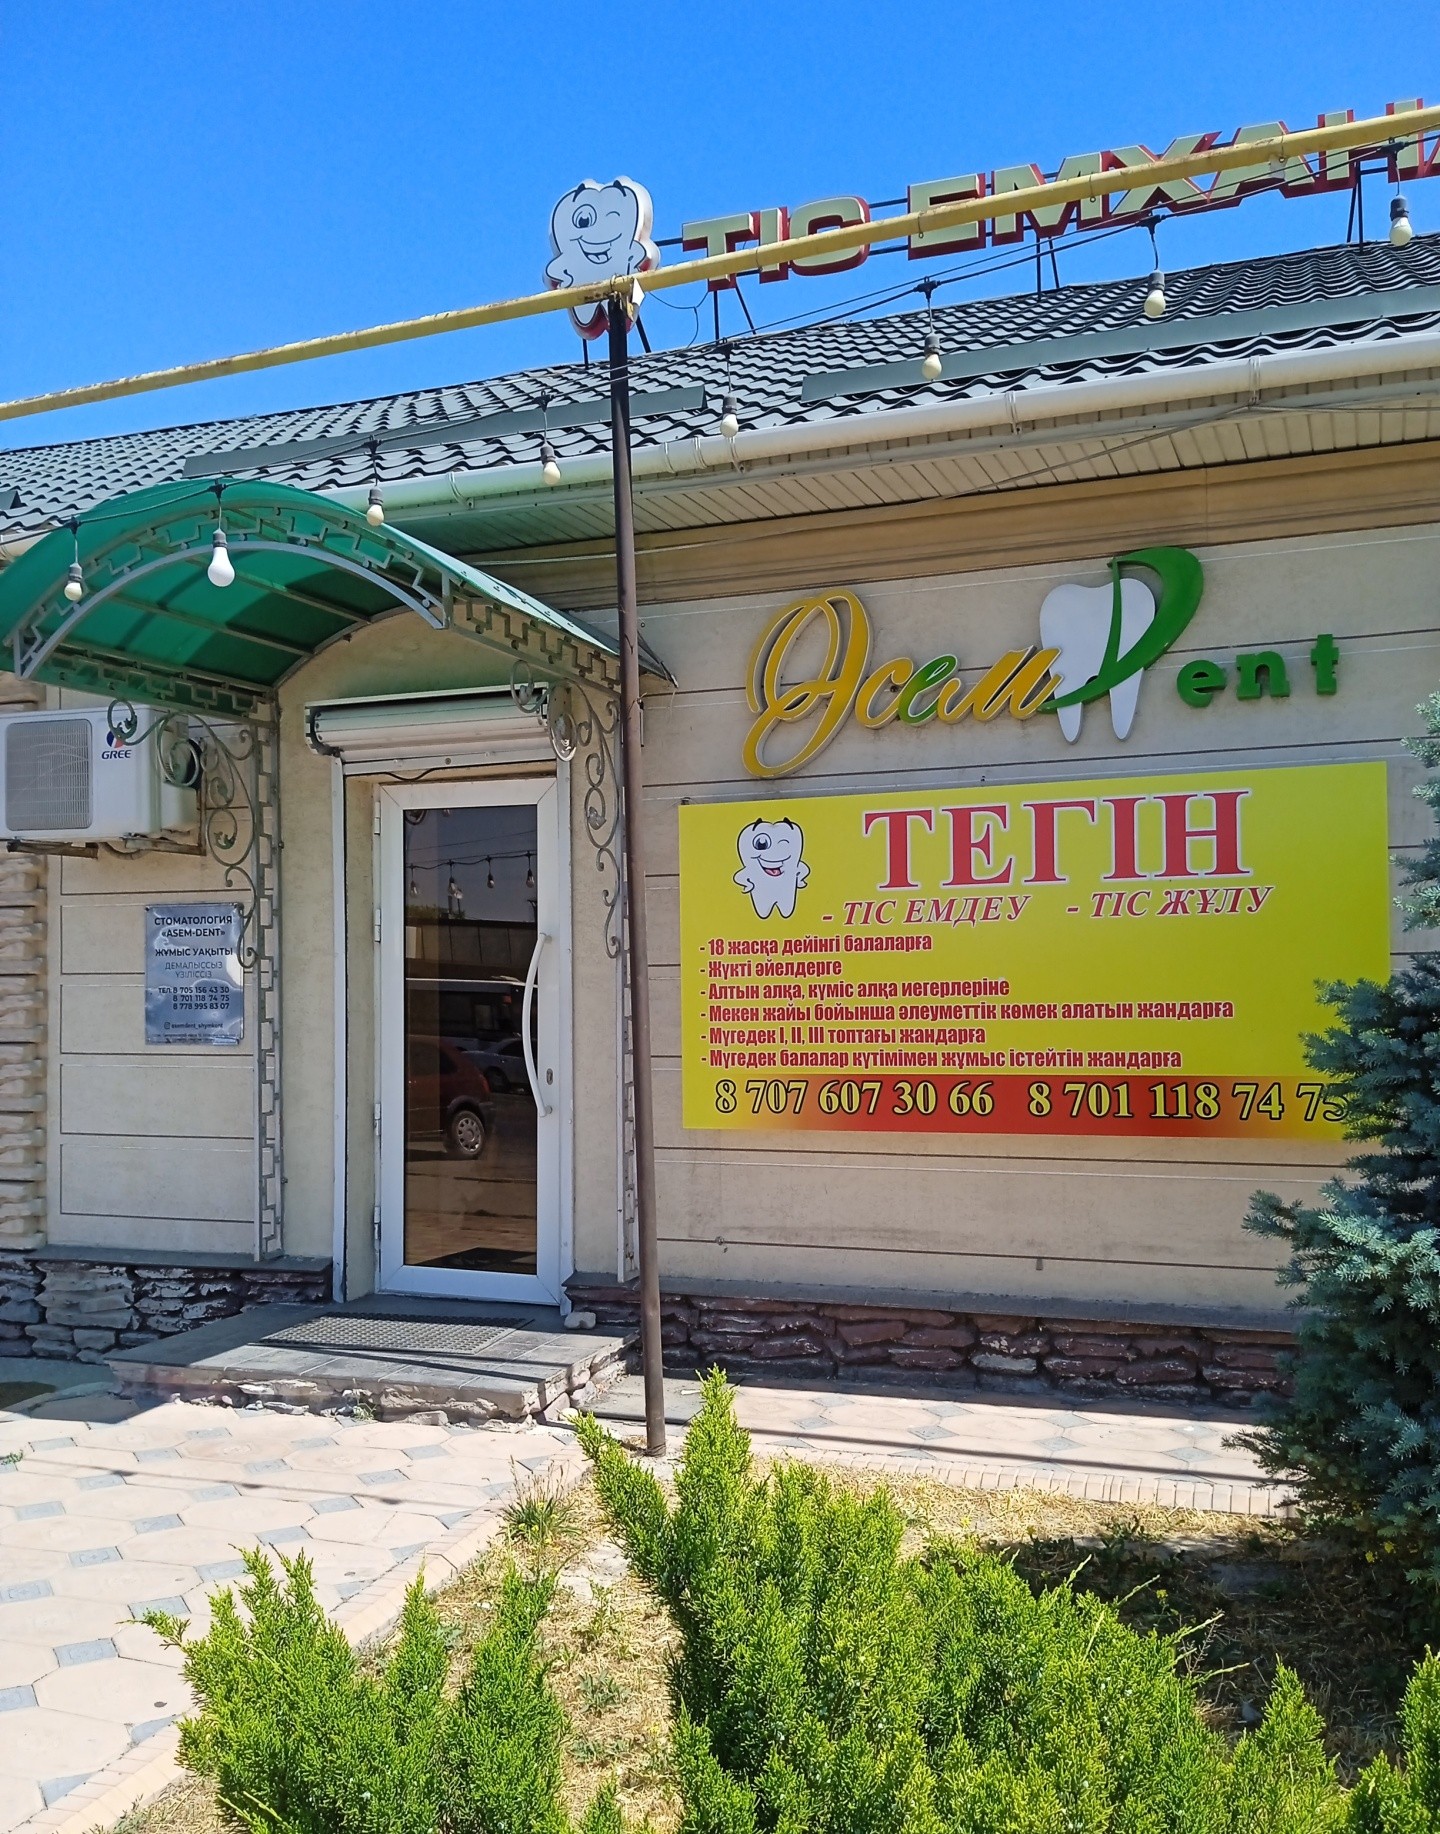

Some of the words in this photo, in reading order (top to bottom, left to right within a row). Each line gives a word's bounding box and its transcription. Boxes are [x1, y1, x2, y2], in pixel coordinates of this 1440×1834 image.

[907, 96, 1440, 261] ЕМХАН
[1037, 546, 1341, 714] Dent
[101, 749, 132, 760] GREE
[863, 789, 1251, 890] ТЕГІН
[843, 900, 896, 925] ТІС
[903, 895, 1031, 928] ЕМДЕУ
[1090, 890, 1151, 918] ТІС
[1156, 886, 1274, 916] ЖҰЛУ
[154, 915, 233, 926] СТОМАТОЛОГИЯ
[161, 928, 226, 938] «ASEM-DENT»
[155, 948, 191, 957] ЖҰМЫС
[192, 947, 233, 957] УАҚЫТЫ
[708, 939, 724, 956] 18
[728, 939, 778, 956] жасқа
[782, 936, 840, 956] дейінгі
[844, 935, 932, 953] балаларға
[165, 961, 223, 970] ДЕМАЛЫССЫЗ
[708, 960, 752, 980] Жүкті
[755, 959, 842, 979] әйелдерге
[180, 986, 193, 994] 705
[208, 986, 218, 994] 43
[220, 986, 230, 994] 30
[180, 994, 193, 1002] 701
[208, 994, 218, 1002] 74
[221, 994, 230, 1002] 75
[708, 983, 760, 1000] Алтын
[763, 983, 805, 1001] алқа,
[808, 981, 854, 1001] күміс
[858, 982, 898, 1000] алқа
[901, 978, 1010, 998] иегерлеріне
[180, 1002, 193, 1010] 778
[194, 1002, 208, 1010] 995
[209, 1002, 219, 1010] 83
[220, 1002, 230, 1010] 07
[709, 1005, 760, 1022] Мекен
[763, 1003, 811, 1021] жайы
[815, 1003, 895, 1021] бойынша
[899, 1001, 997, 1021] әлеуметтік
[1000, 1003, 1058, 1020] көмек
[1061, 1002, 1133, 1019] алатын
[1138, 1001, 1234, 1021] жандарға
[709, 1027, 776, 1046] Мүгедек
[828, 1027, 896, 1044] топтағы
[899, 1027, 986, 1045] жандарға
[710, 1049, 777, 1069] Мүгедек
[780, 1049, 849, 1068] балалар
[853, 1048, 937, 1068] күтімімен
[941, 1050, 1006, 1070] жұмыс
[1009, 1048, 1084, 1068] істейтін
[1087, 1050, 1182, 1069] жандарға
[715, 1079, 737, 1114] 8
[746, 1079, 809, 1114] 707
[819, 1079, 882, 1115] 607
[893, 1080, 937, 1115] 30
[949, 1079, 994, 1115] 66
[1027, 1081, 1051, 1117] 8
[1063, 1082, 1133, 1118] 701
[1149, 1082, 1221, 1119] 118
[1231, 1082, 1284, 1120] 74
